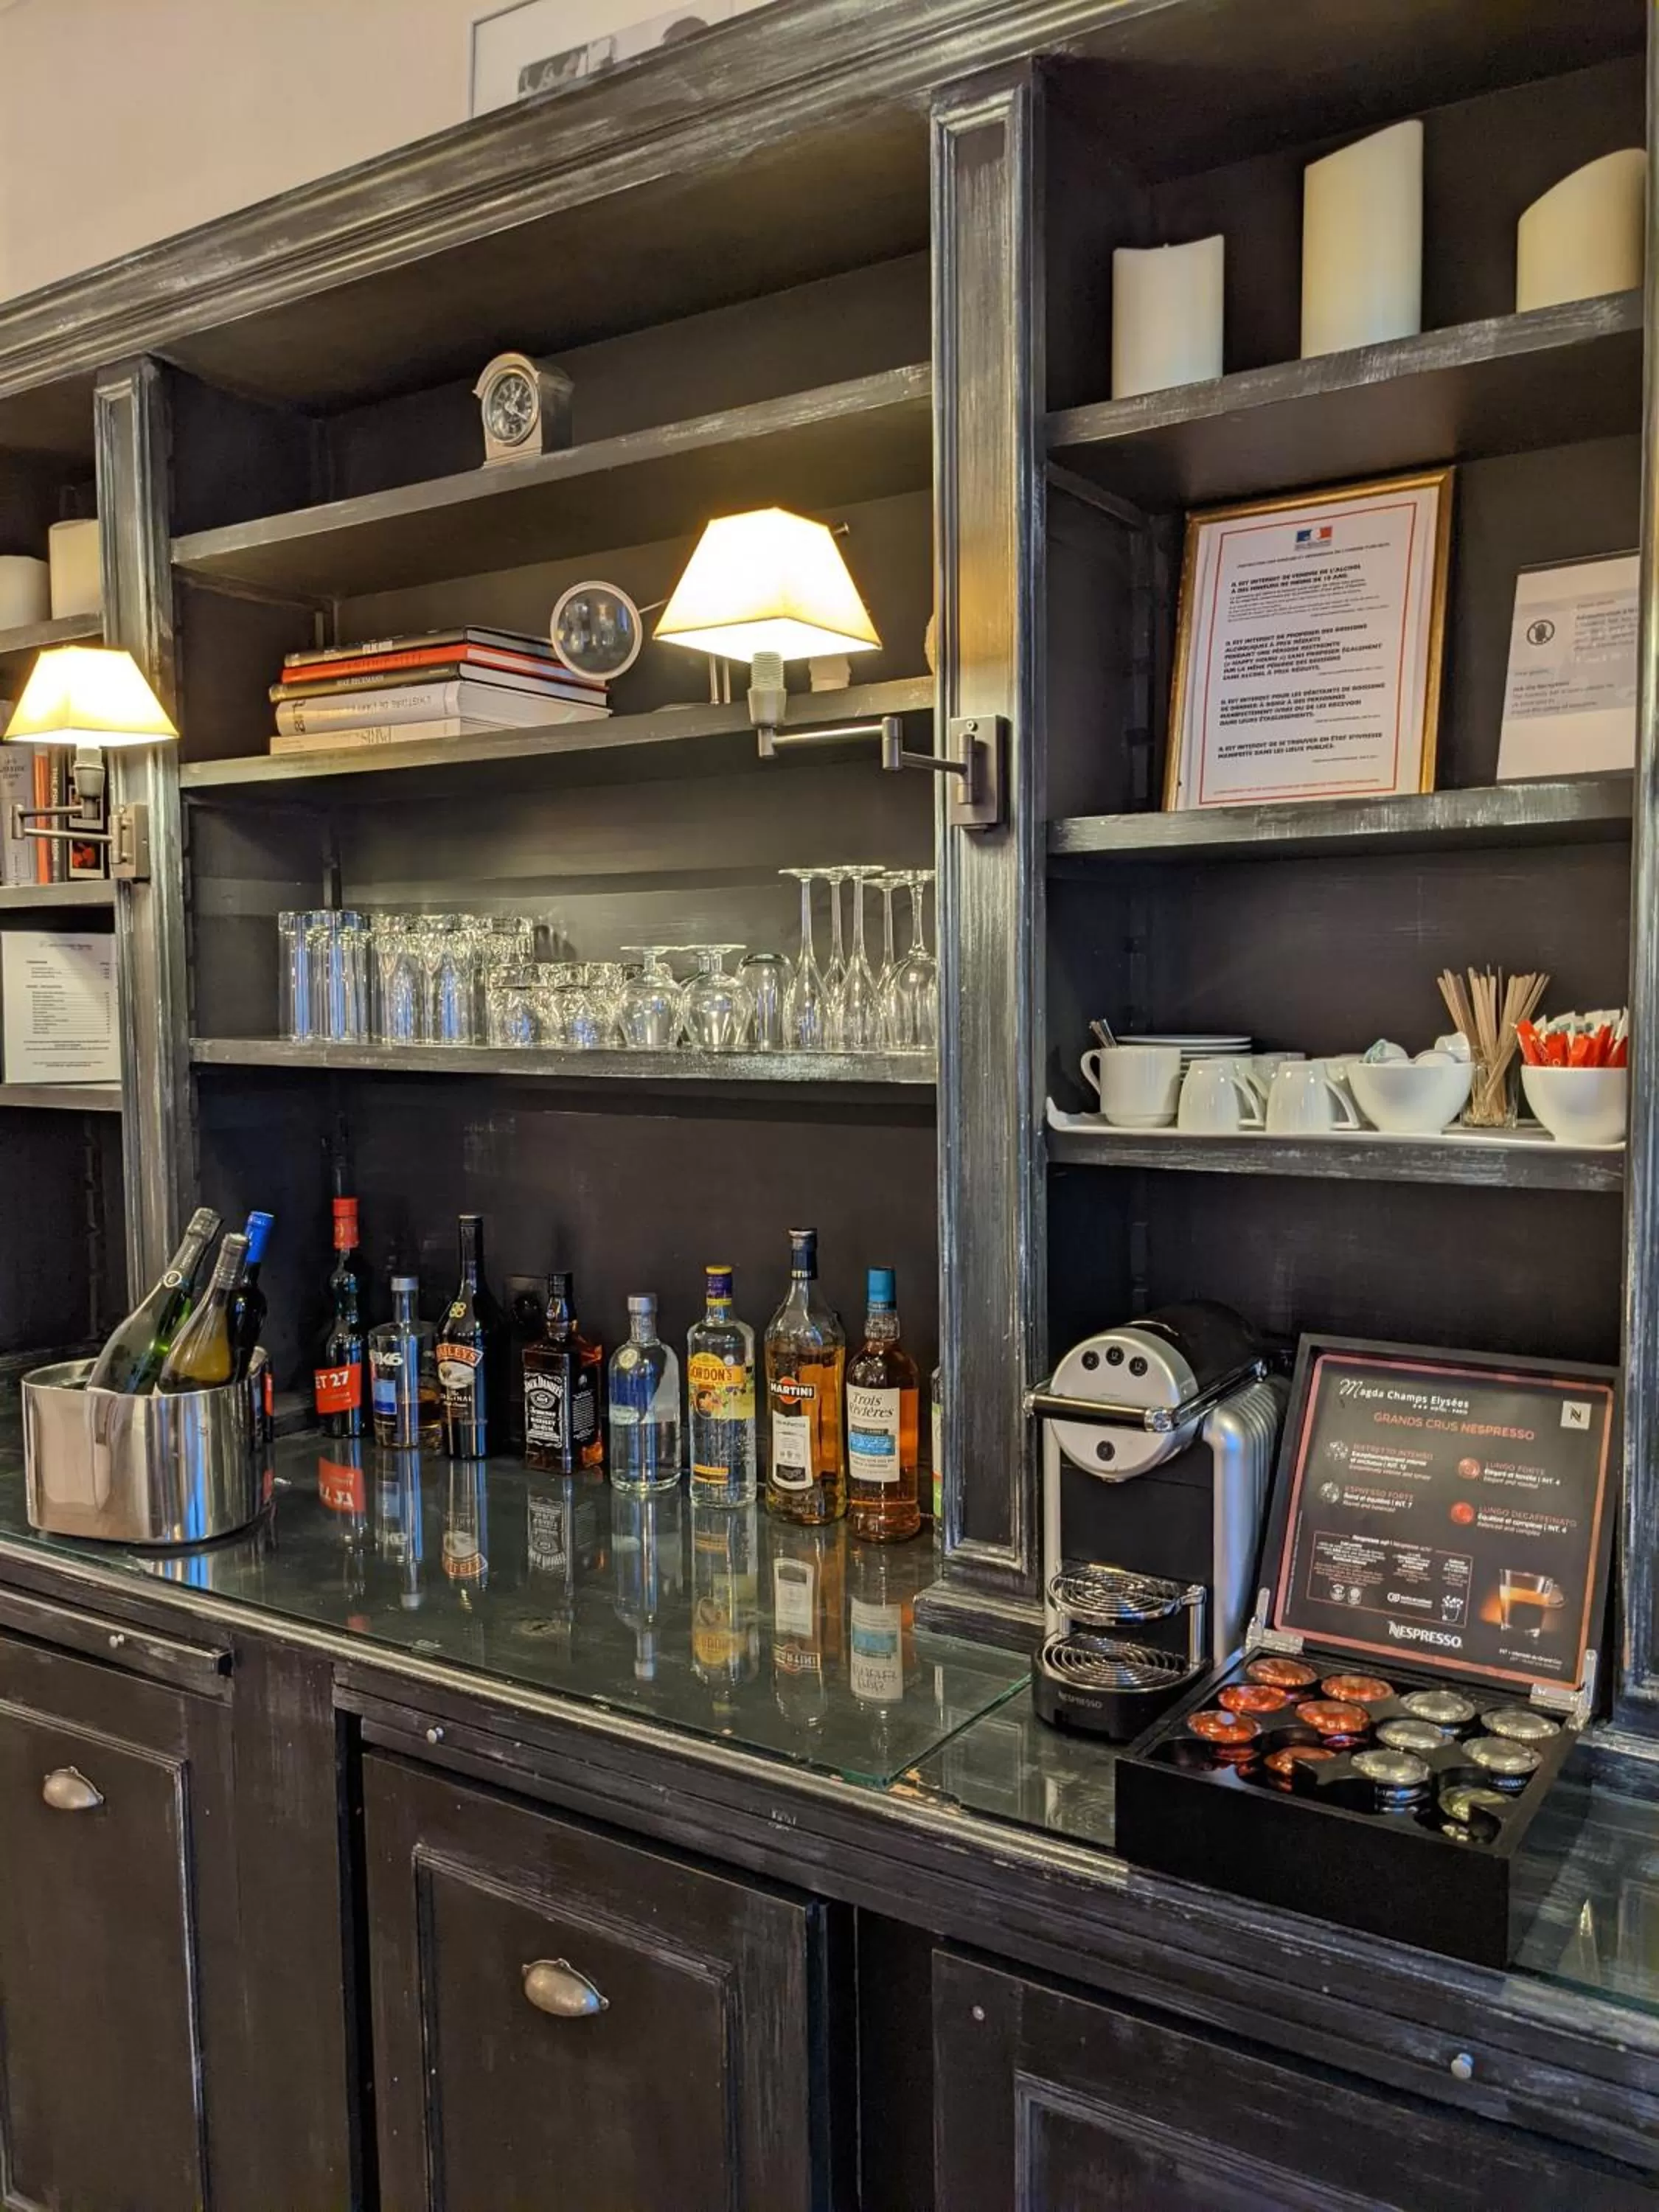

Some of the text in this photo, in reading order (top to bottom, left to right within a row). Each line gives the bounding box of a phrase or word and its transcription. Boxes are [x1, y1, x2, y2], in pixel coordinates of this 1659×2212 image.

[330, 1370, 349, 1388] 27
[771, 1383, 813, 1397] MARTINI
[854, 1392, 882, 1406] Trois
[1338, 1377, 1385, 1402] Magda
[1386, 1390, 1428, 1405] Champs
[1373, 1411, 1536, 1441] GRANDS CRUS NESPRESSO
[1385, 1620, 1463, 1651] NESPRESSO
